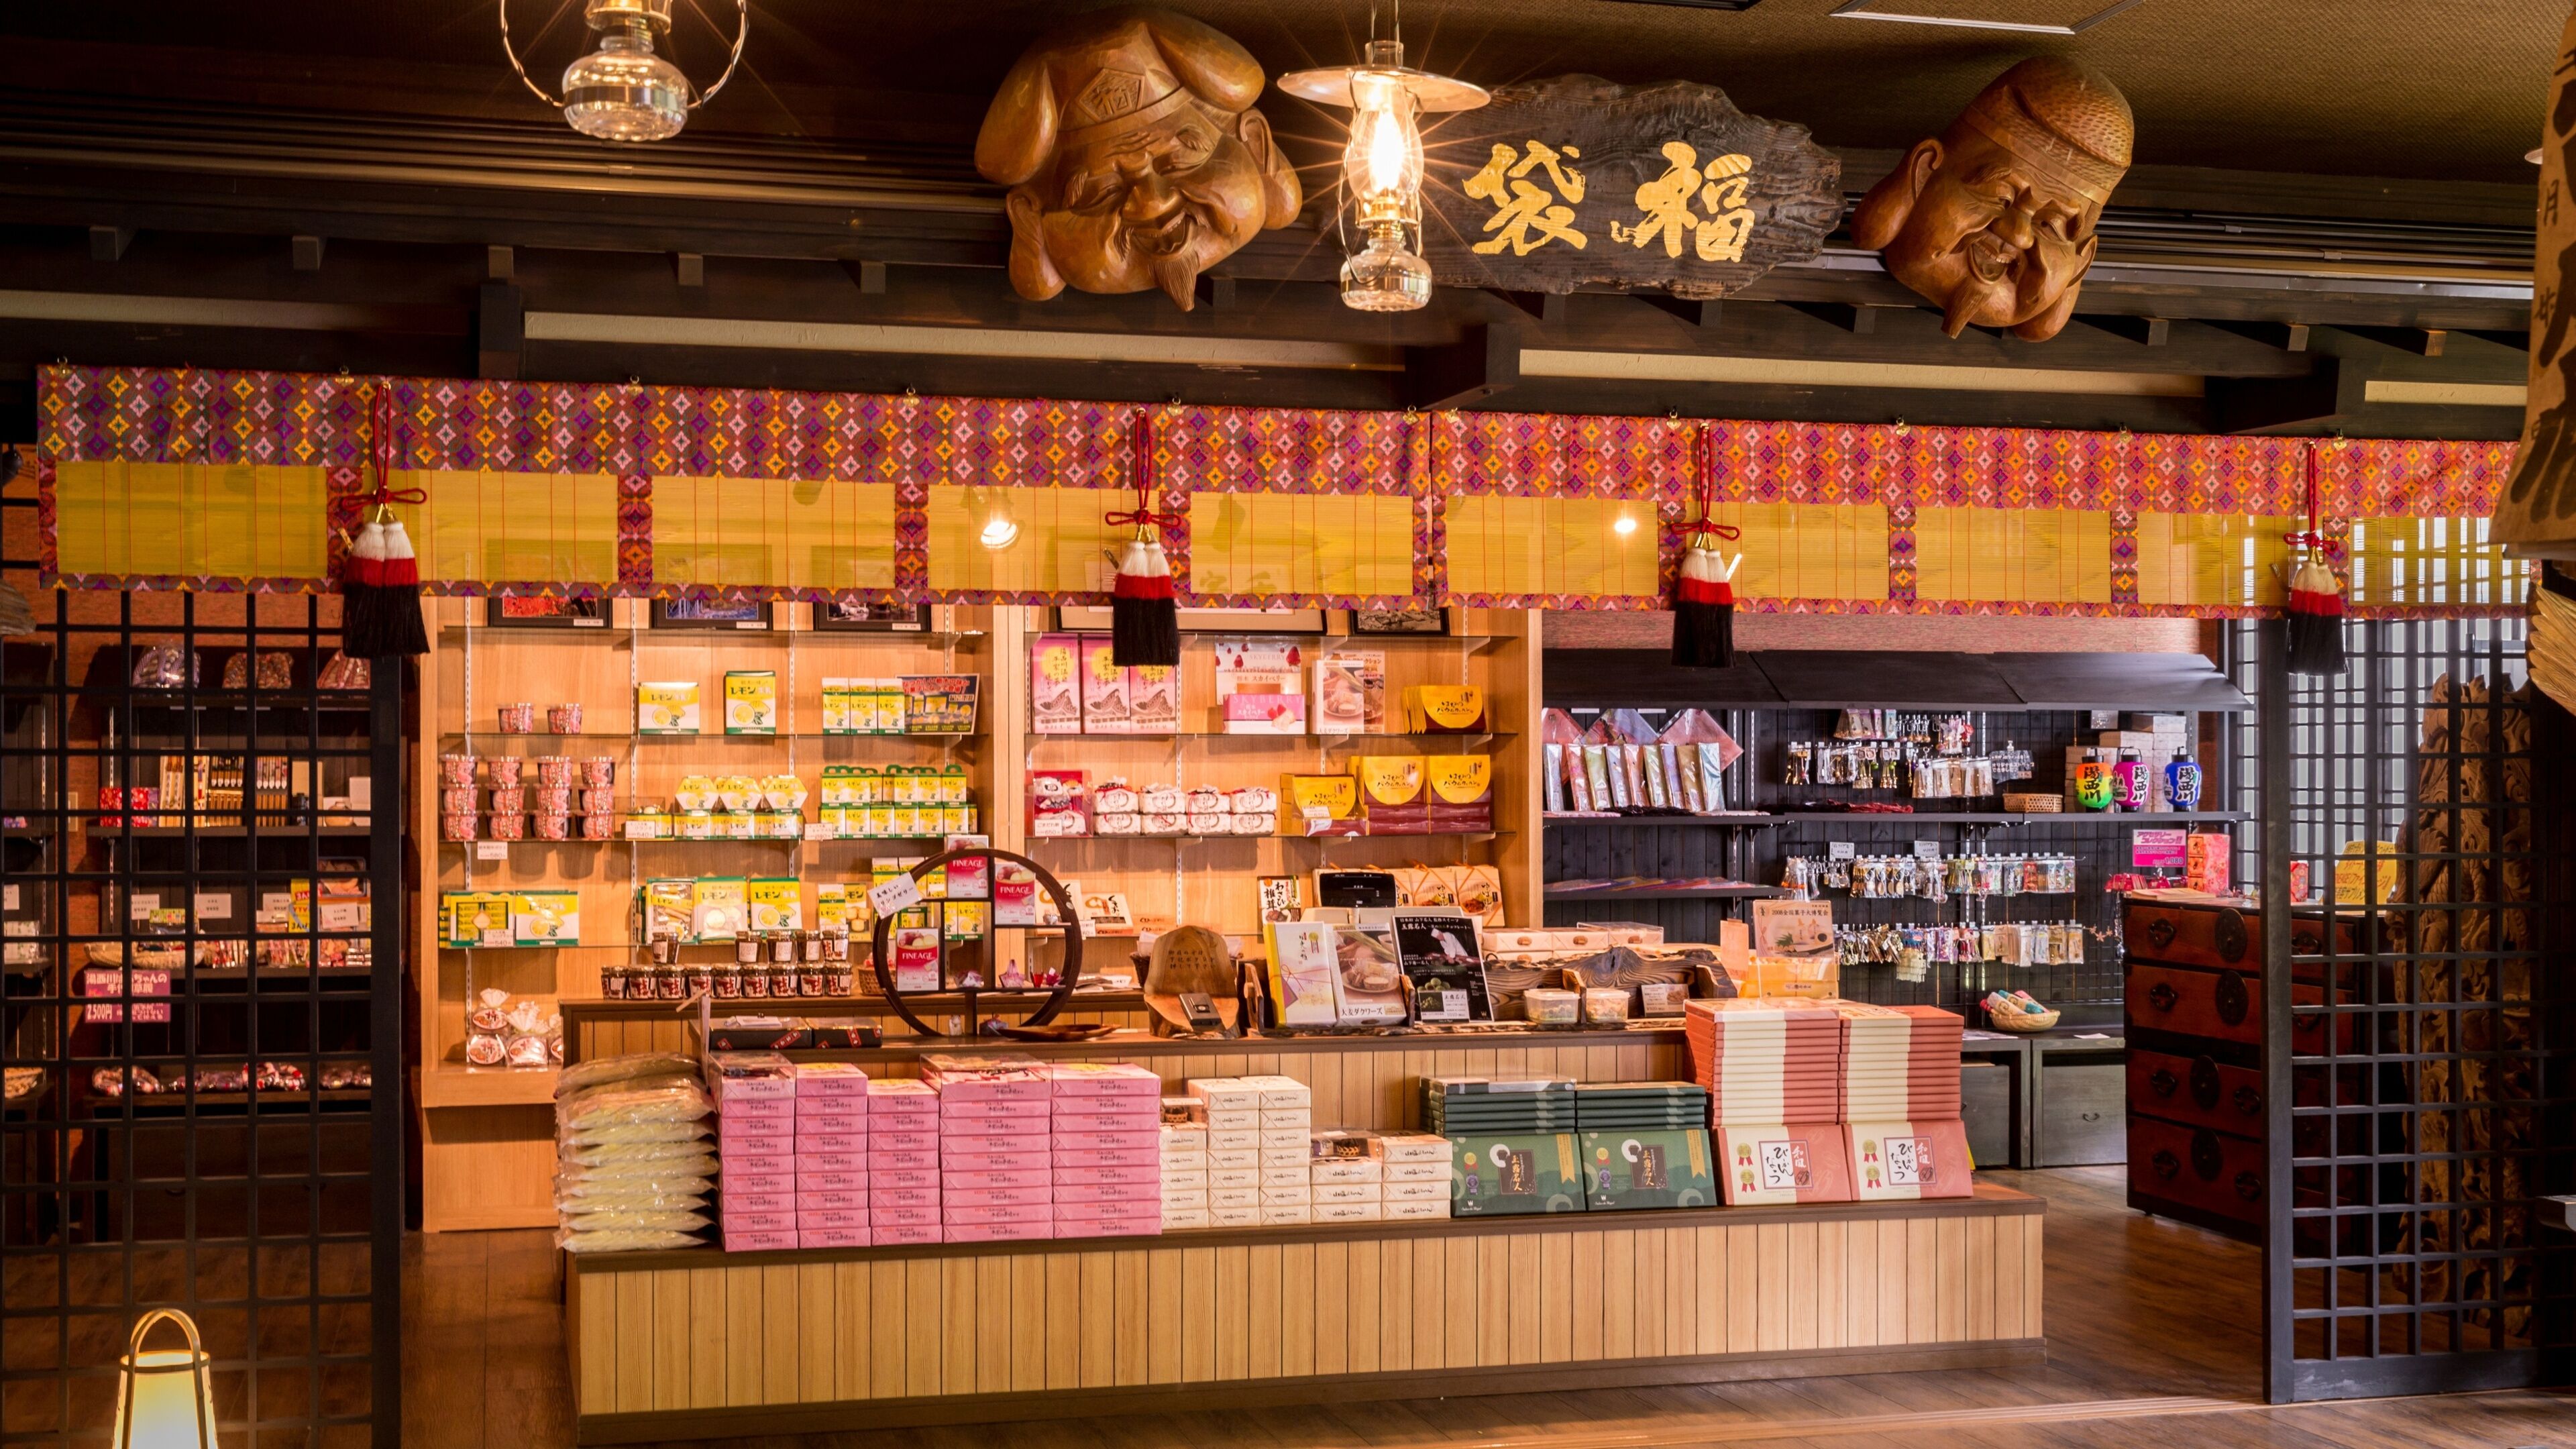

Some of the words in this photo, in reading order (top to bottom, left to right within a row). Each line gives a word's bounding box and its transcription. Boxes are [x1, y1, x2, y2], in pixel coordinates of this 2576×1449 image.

[1234, 695, 1301, 704] SKYBERRY
[2084, 765, 2102, 803] 湯西川
[2178, 766, 2195, 803] 湯西川
[845, 890, 864, 899] モン
[1000, 886, 1030, 894] FINEAGE
[902, 952, 933, 960] FINEAGE
[87, 973, 168, 985] 湯西川ちゃんの
[1792, 1146, 1807, 1168] 和風
[1917, 1142, 1931, 1166] 和風
